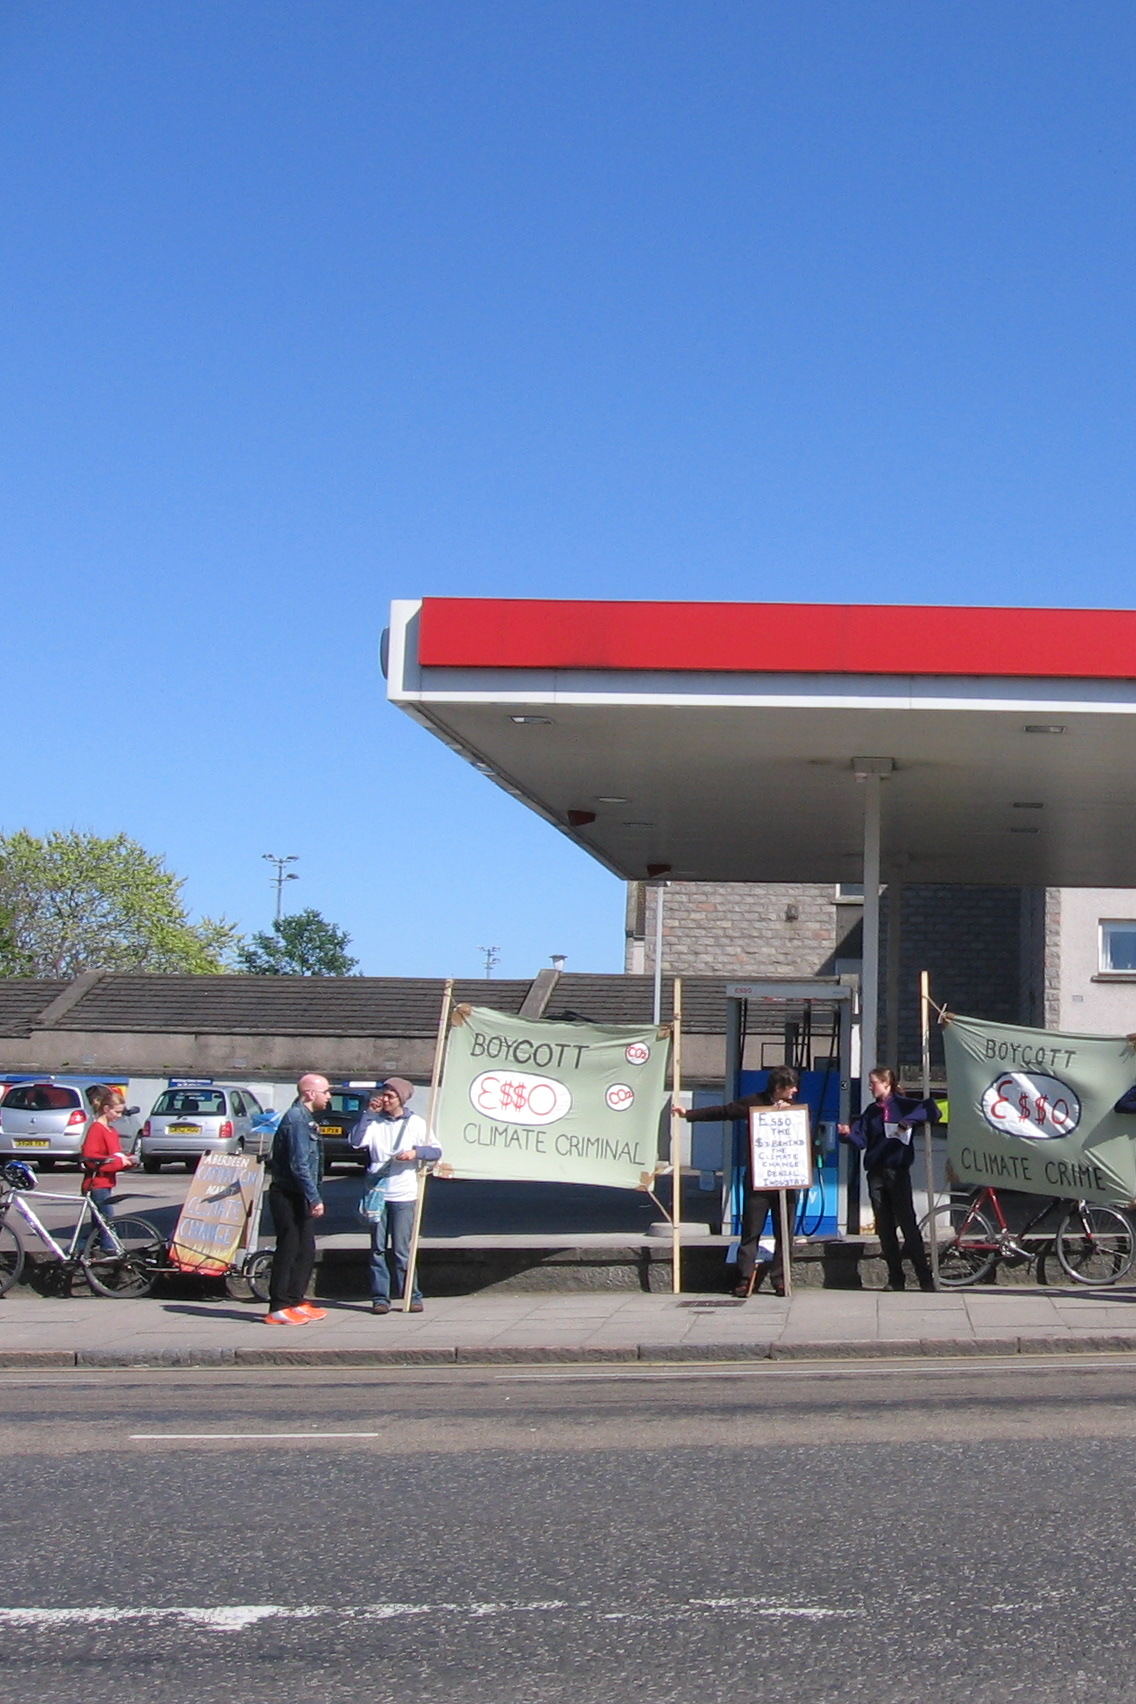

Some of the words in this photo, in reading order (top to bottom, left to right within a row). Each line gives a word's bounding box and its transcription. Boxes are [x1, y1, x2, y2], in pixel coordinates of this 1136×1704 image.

[470, 1033, 590, 1069] BOYCOTT
[985, 1039, 1077, 1069] BOYCOTT
[758, 1113, 792, 1126] ESSO
[463, 1122, 547, 1154] CLIMATE
[554, 1134, 645, 1166] CRIMINAL
[204, 1154, 250, 1167] ABERDEEN
[758, 1151, 798, 1160] CLIMATE
[767, 1169, 799, 1177] DENIAL
[961, 1147, 1032, 1181] CLIMATE
[1044, 1161, 1107, 1191] CRIME
[764, 1178, 805, 1186] INDUSTRY
[179, 1218, 234, 1246] CHANGE
